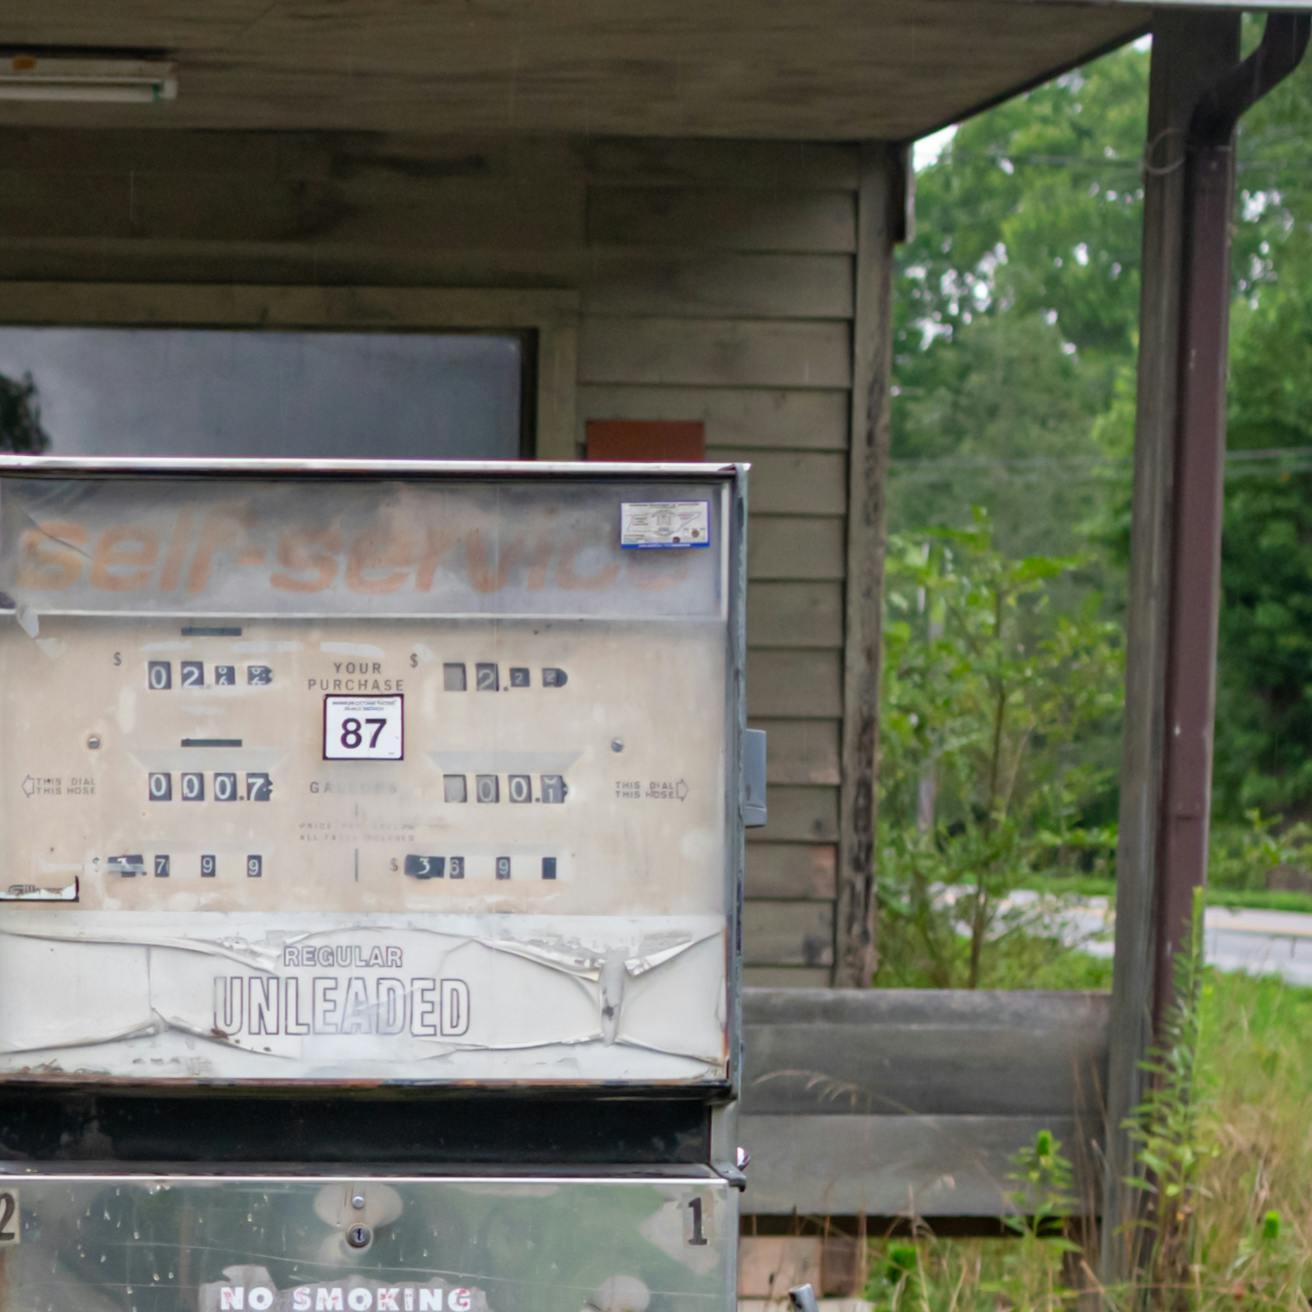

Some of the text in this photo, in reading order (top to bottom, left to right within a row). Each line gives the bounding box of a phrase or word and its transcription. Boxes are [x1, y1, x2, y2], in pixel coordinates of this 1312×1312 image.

[113, 652, 122, 666] $
[409, 653, 419, 668] $
[333, 662, 382, 674] YOUR
[308, 679, 404, 692] PURCHASE
[340, 718, 387, 749] 87
[36, 777, 96, 786] THIS DIAL
[615, 781, 674, 790] THIS DIAL
[36, 786, 96, 795] THIS HOSE
[615, 790, 674, 799] THIS HOSE
[283, 946, 403, 968] REGULAR
[214, 976, 470, 1037] UNLEADED
[687, 1198, 708, 1246] 1
[220, 1286, 474, 1312] NO SMOKING
